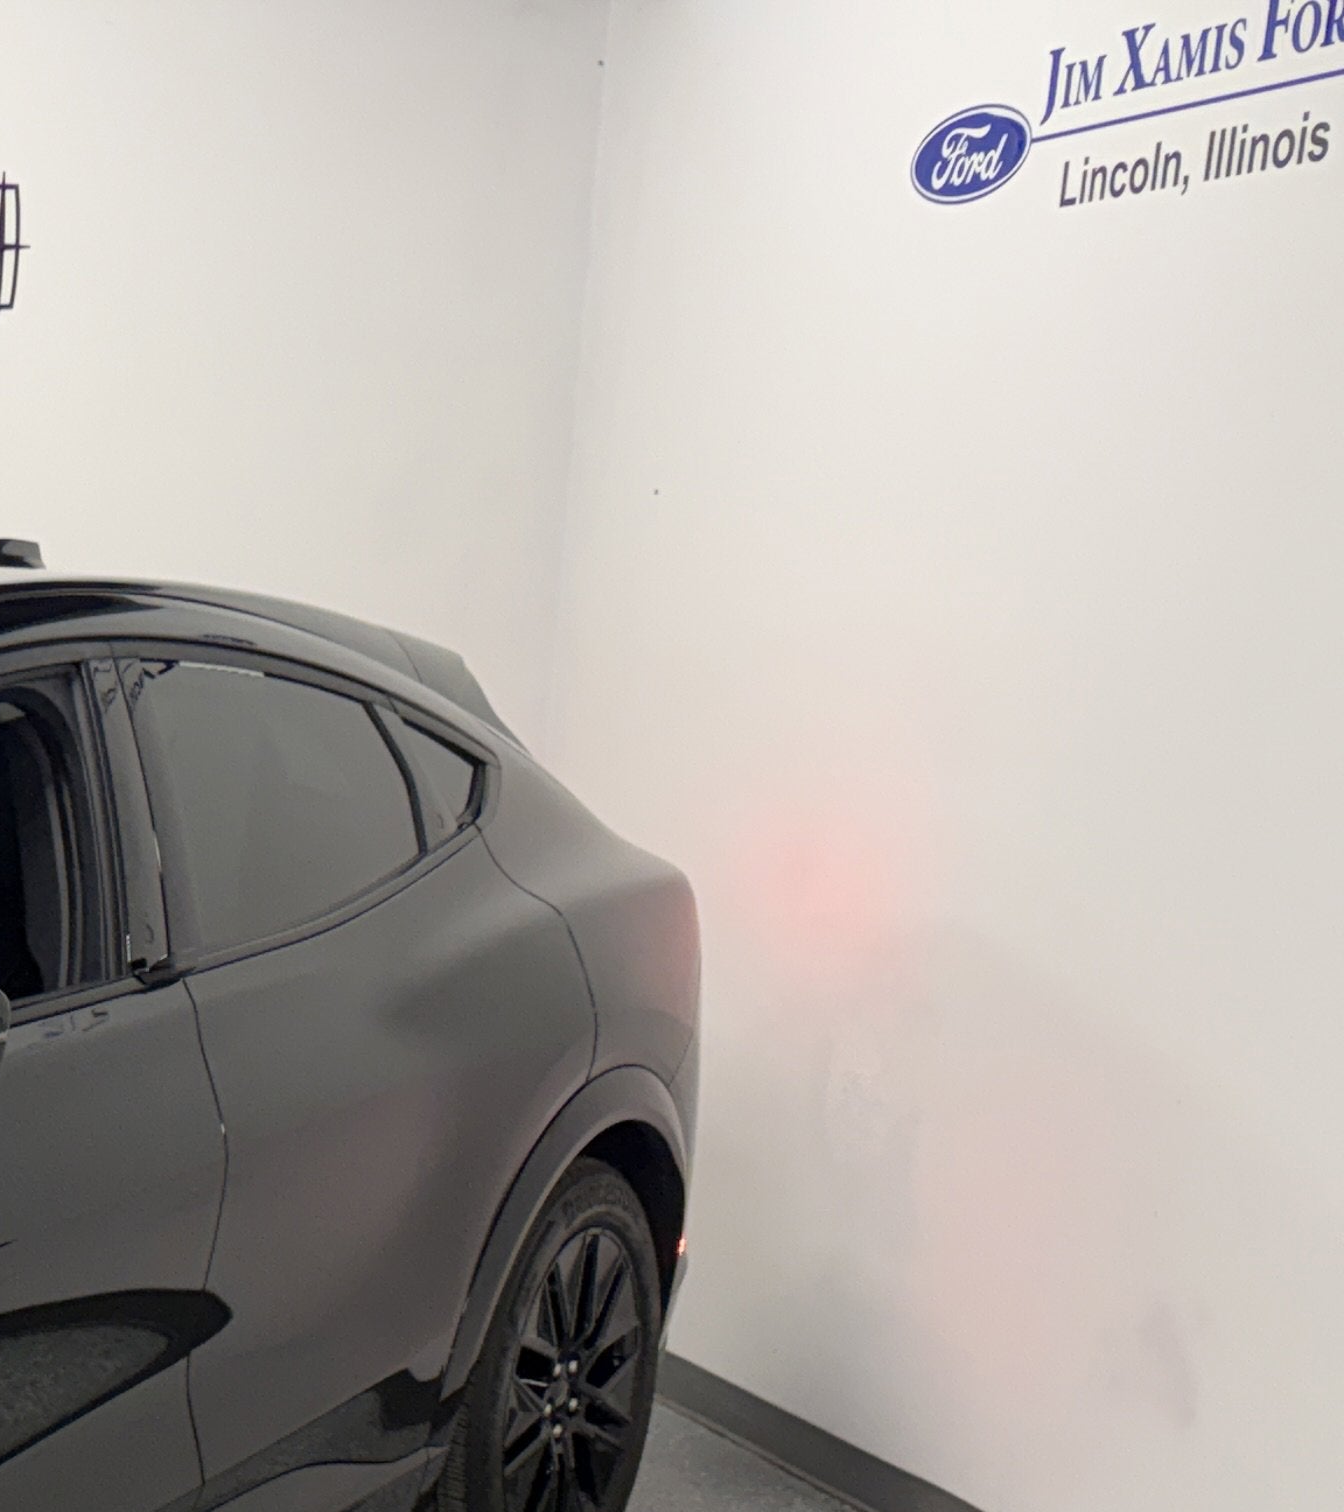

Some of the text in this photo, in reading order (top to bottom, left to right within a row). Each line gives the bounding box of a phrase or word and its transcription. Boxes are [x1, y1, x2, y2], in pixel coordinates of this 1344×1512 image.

[1040, 47, 1108, 126] JIM
[1113, 18, 1248, 95] XAMIS
[931, 123, 1009, 191] Ford
[1059, 111, 1331, 208] Lincoln, Illinois
